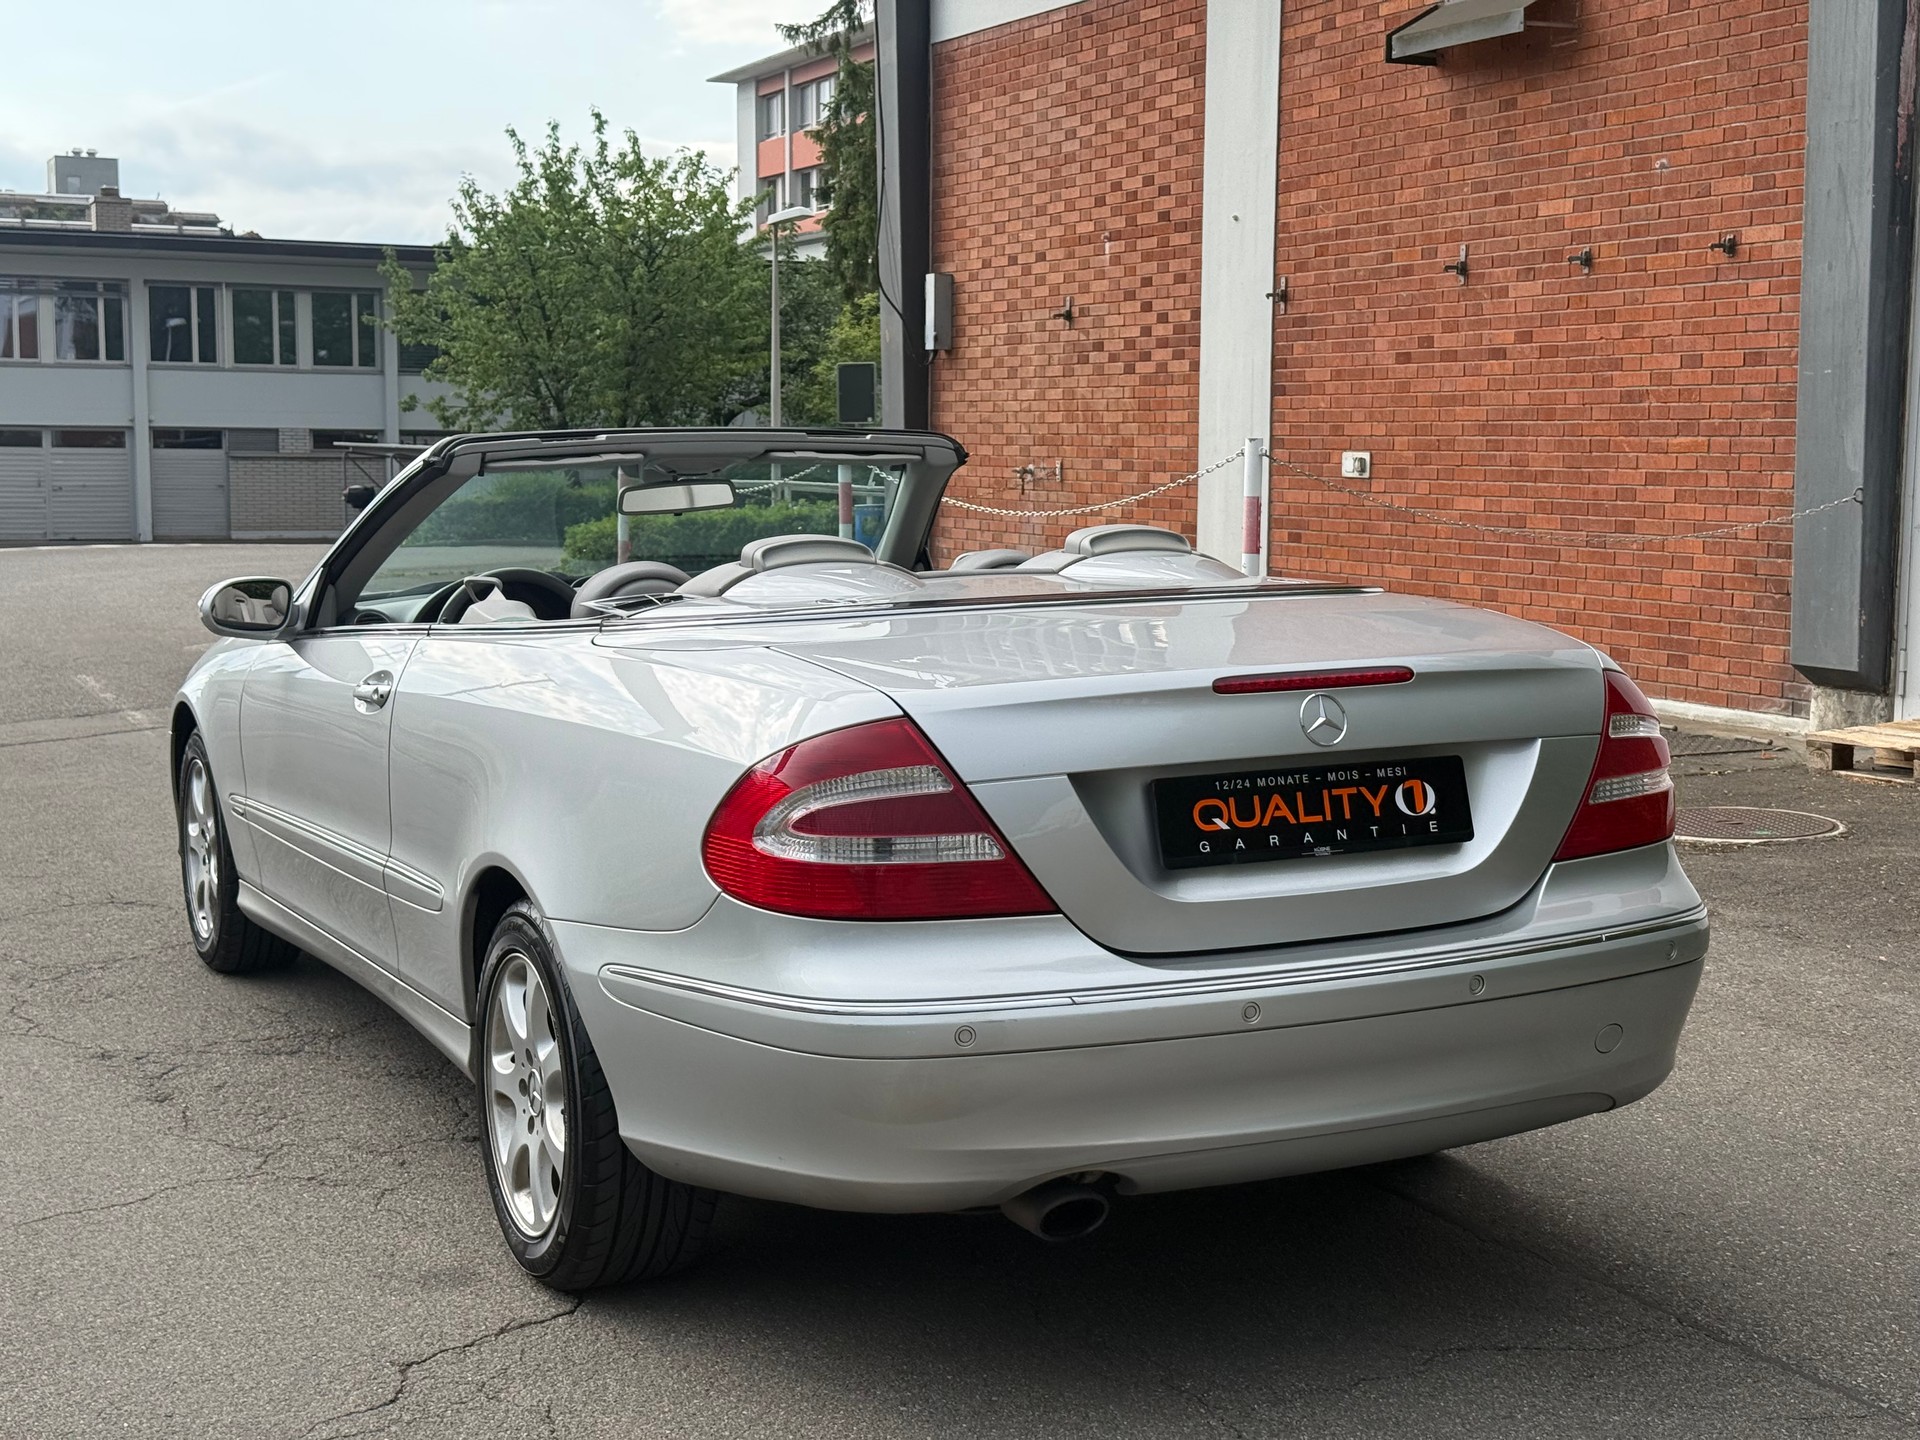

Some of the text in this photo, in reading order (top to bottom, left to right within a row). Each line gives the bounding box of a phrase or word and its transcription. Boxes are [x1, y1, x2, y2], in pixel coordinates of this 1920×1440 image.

[1214, 779, 1250, 791] 12/24
[1257, 774, 1309, 787] MONATE
[1327, 770, 1359, 782] MOIS
[1376, 766, 1407, 778] MESI
[1193, 784, 1388, 832] QUALITY
[1199, 820, 1439, 853] GARANTIE
